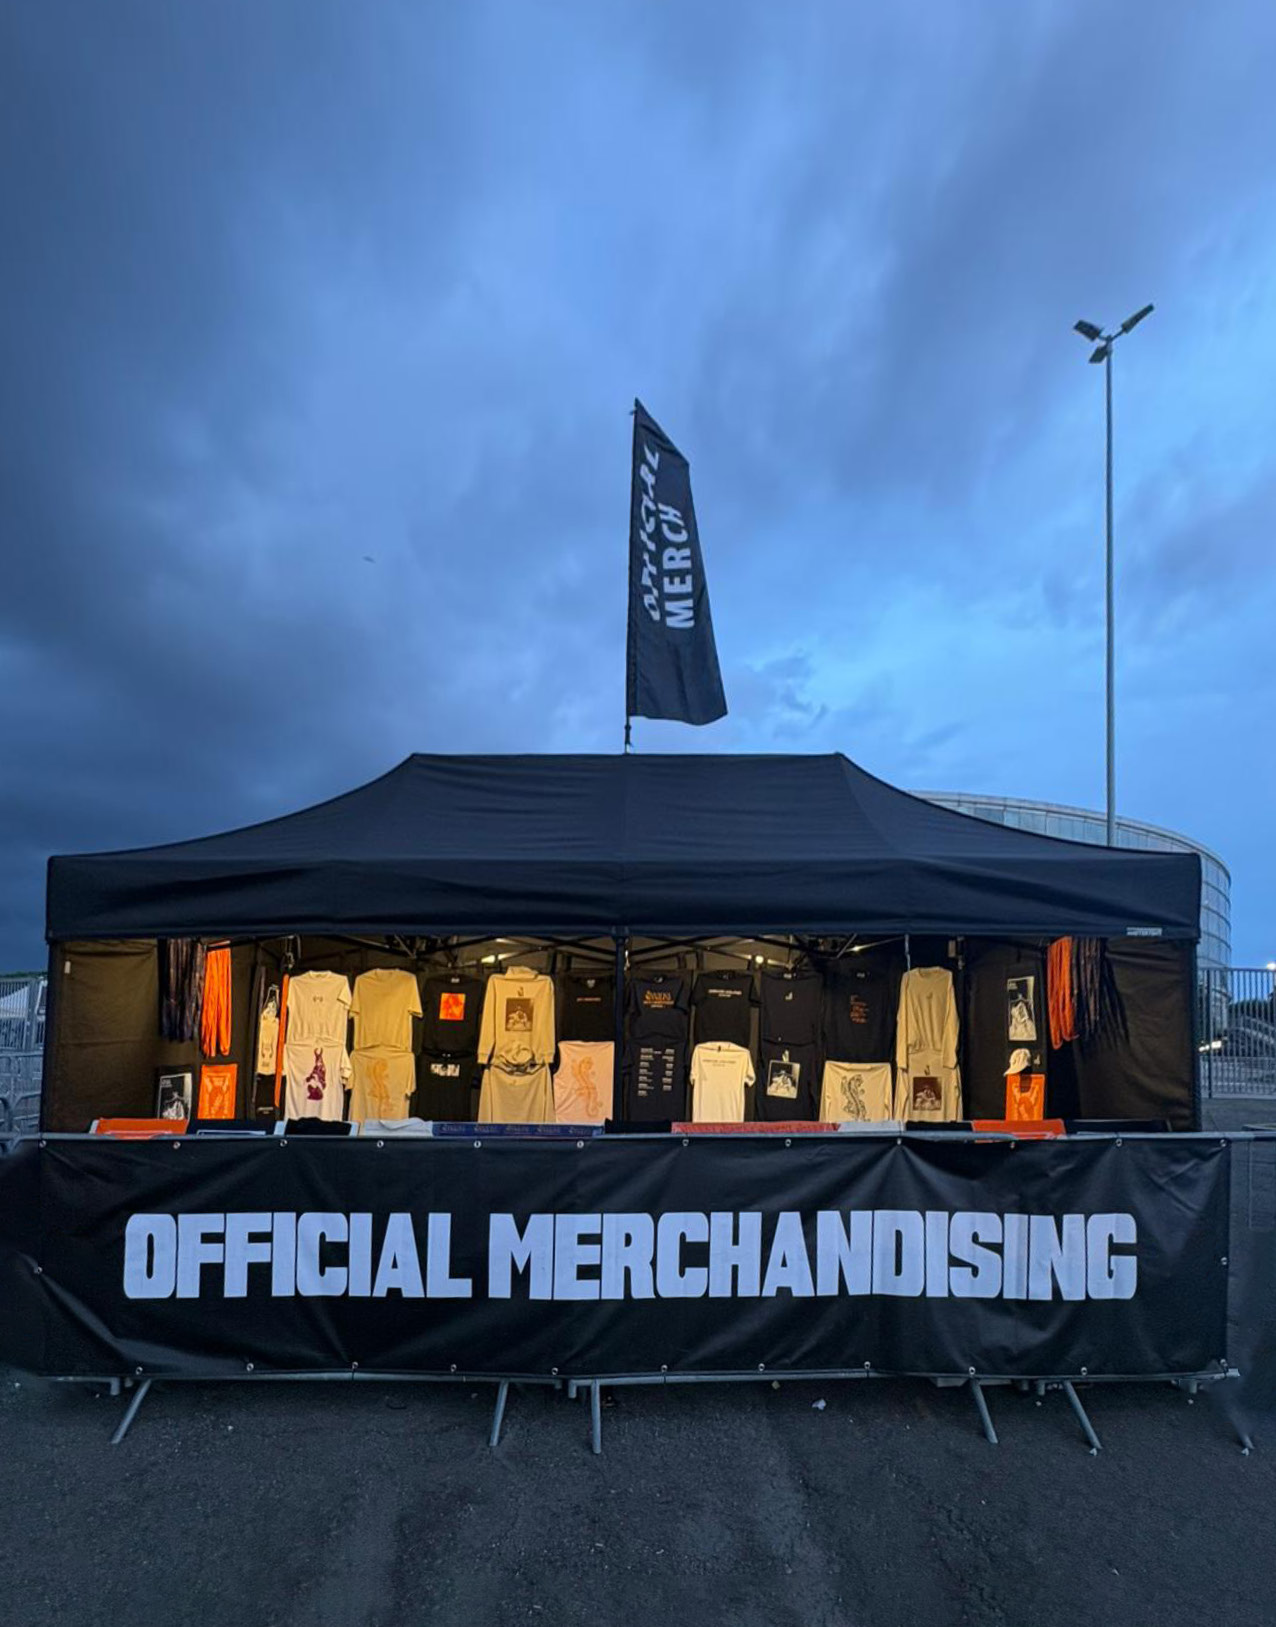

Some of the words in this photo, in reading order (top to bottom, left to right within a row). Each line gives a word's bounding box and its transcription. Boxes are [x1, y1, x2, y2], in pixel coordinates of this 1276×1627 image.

[658, 502, 694, 630] MERCH
[123, 1211, 472, 1299] OFFICIAL
[488, 1210, 1137, 1300] MERCHANDISING
